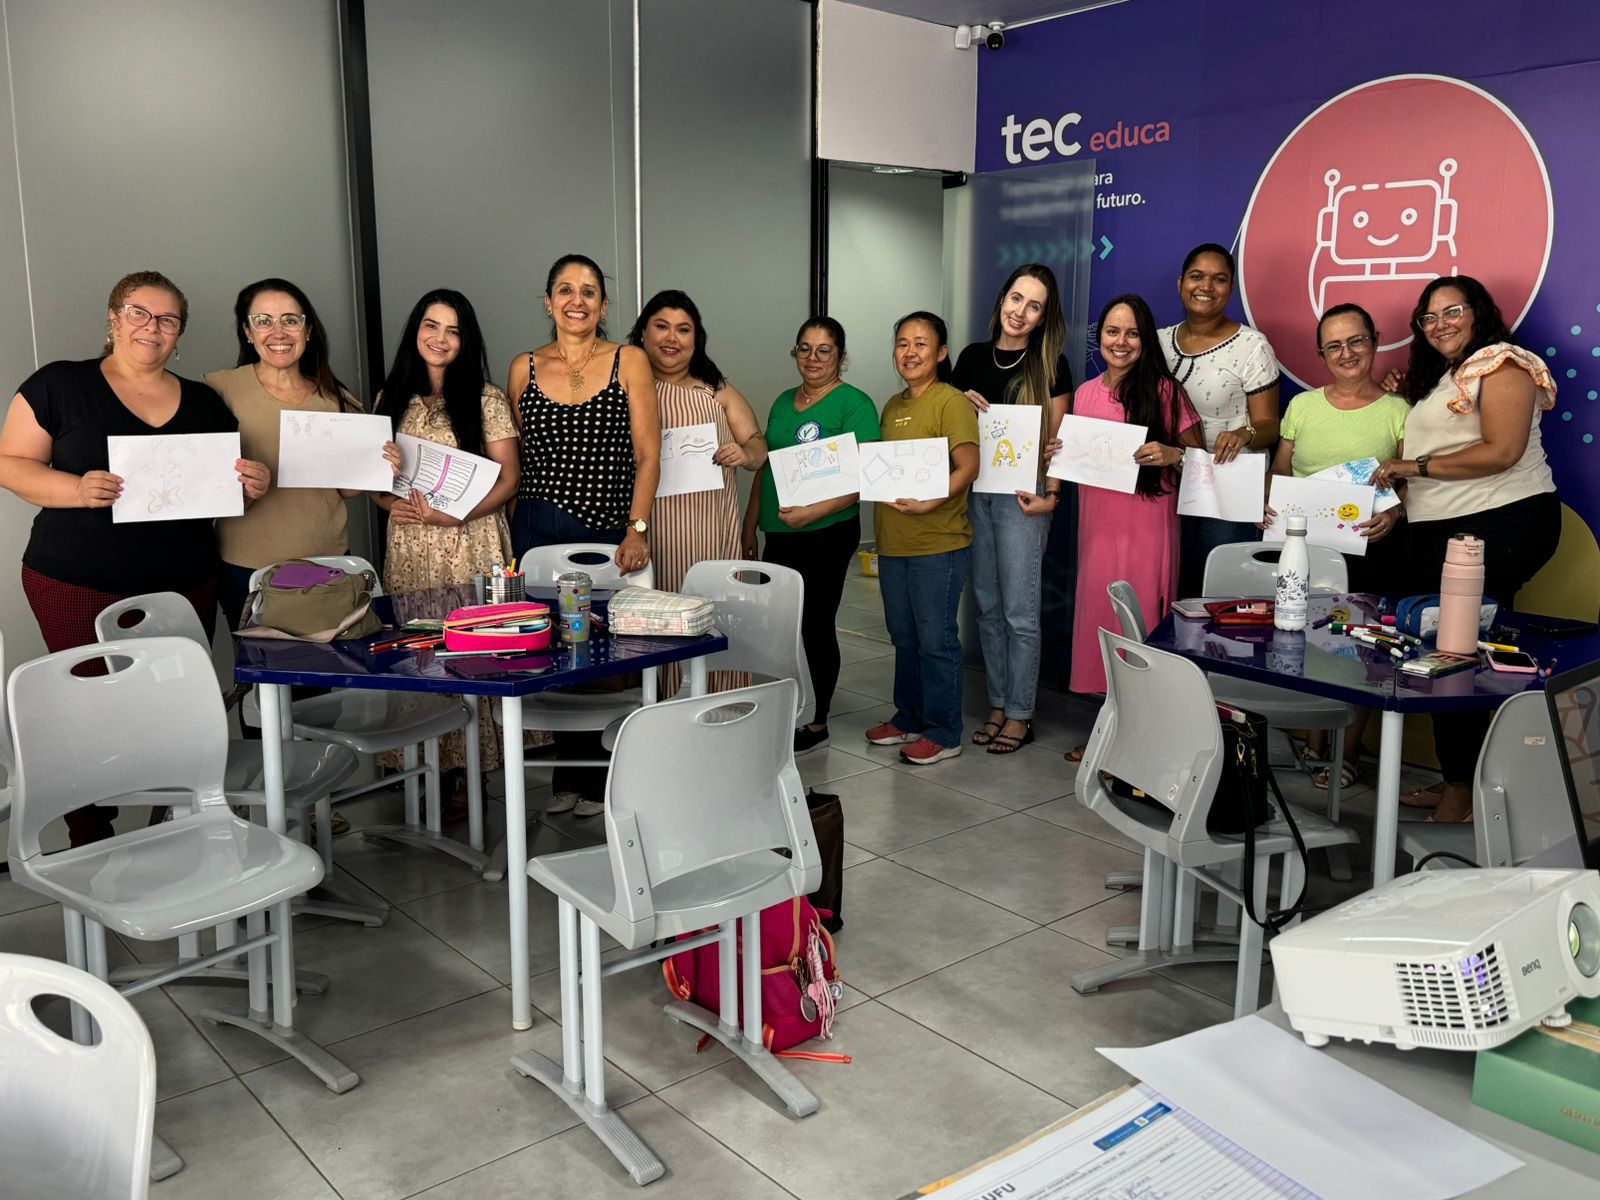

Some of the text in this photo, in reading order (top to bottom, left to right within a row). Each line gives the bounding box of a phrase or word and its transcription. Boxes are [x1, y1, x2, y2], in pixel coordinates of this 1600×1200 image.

[1001, 112, 1171, 165] tec educa
[1093, 172, 1114, 186] ara
[1096, 192, 1146, 209] futuro.
[1521, 958, 1542, 977] BenQ
